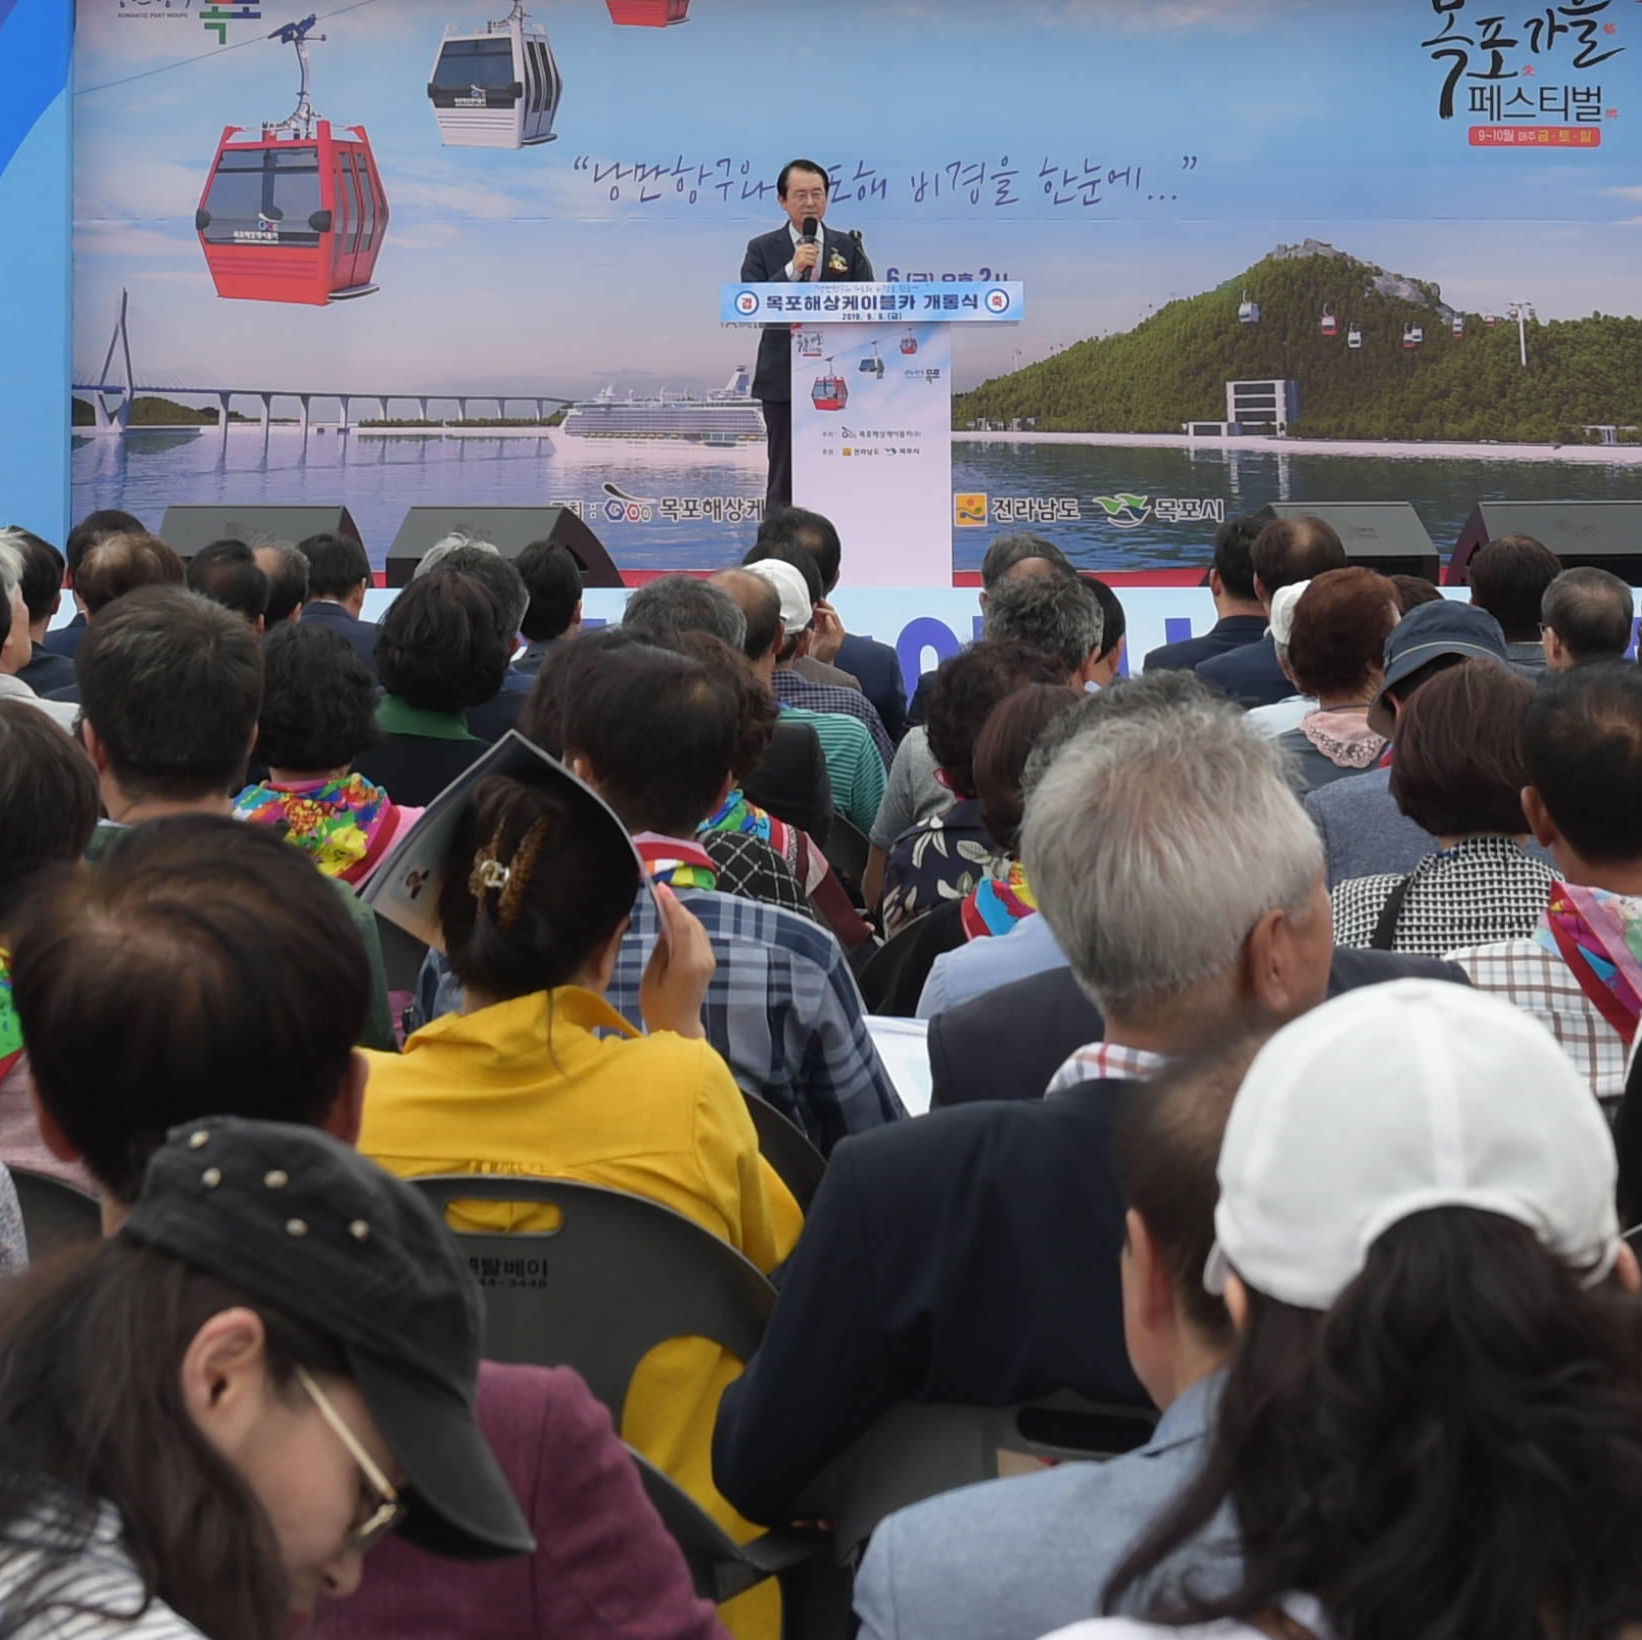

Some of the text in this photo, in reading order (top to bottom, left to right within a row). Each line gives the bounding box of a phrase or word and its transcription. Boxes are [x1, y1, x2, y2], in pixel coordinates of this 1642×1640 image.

[1468, 84, 1602, 122] 페스티벌
[909, 155, 1020, 207] 비경을
[766, 294, 916, 312] 목포해상케이블카
[923, 293, 979, 311] 개통식
[991, 497, 1082, 523] 전라남도
[1154, 498, 1225, 523] 목포시
